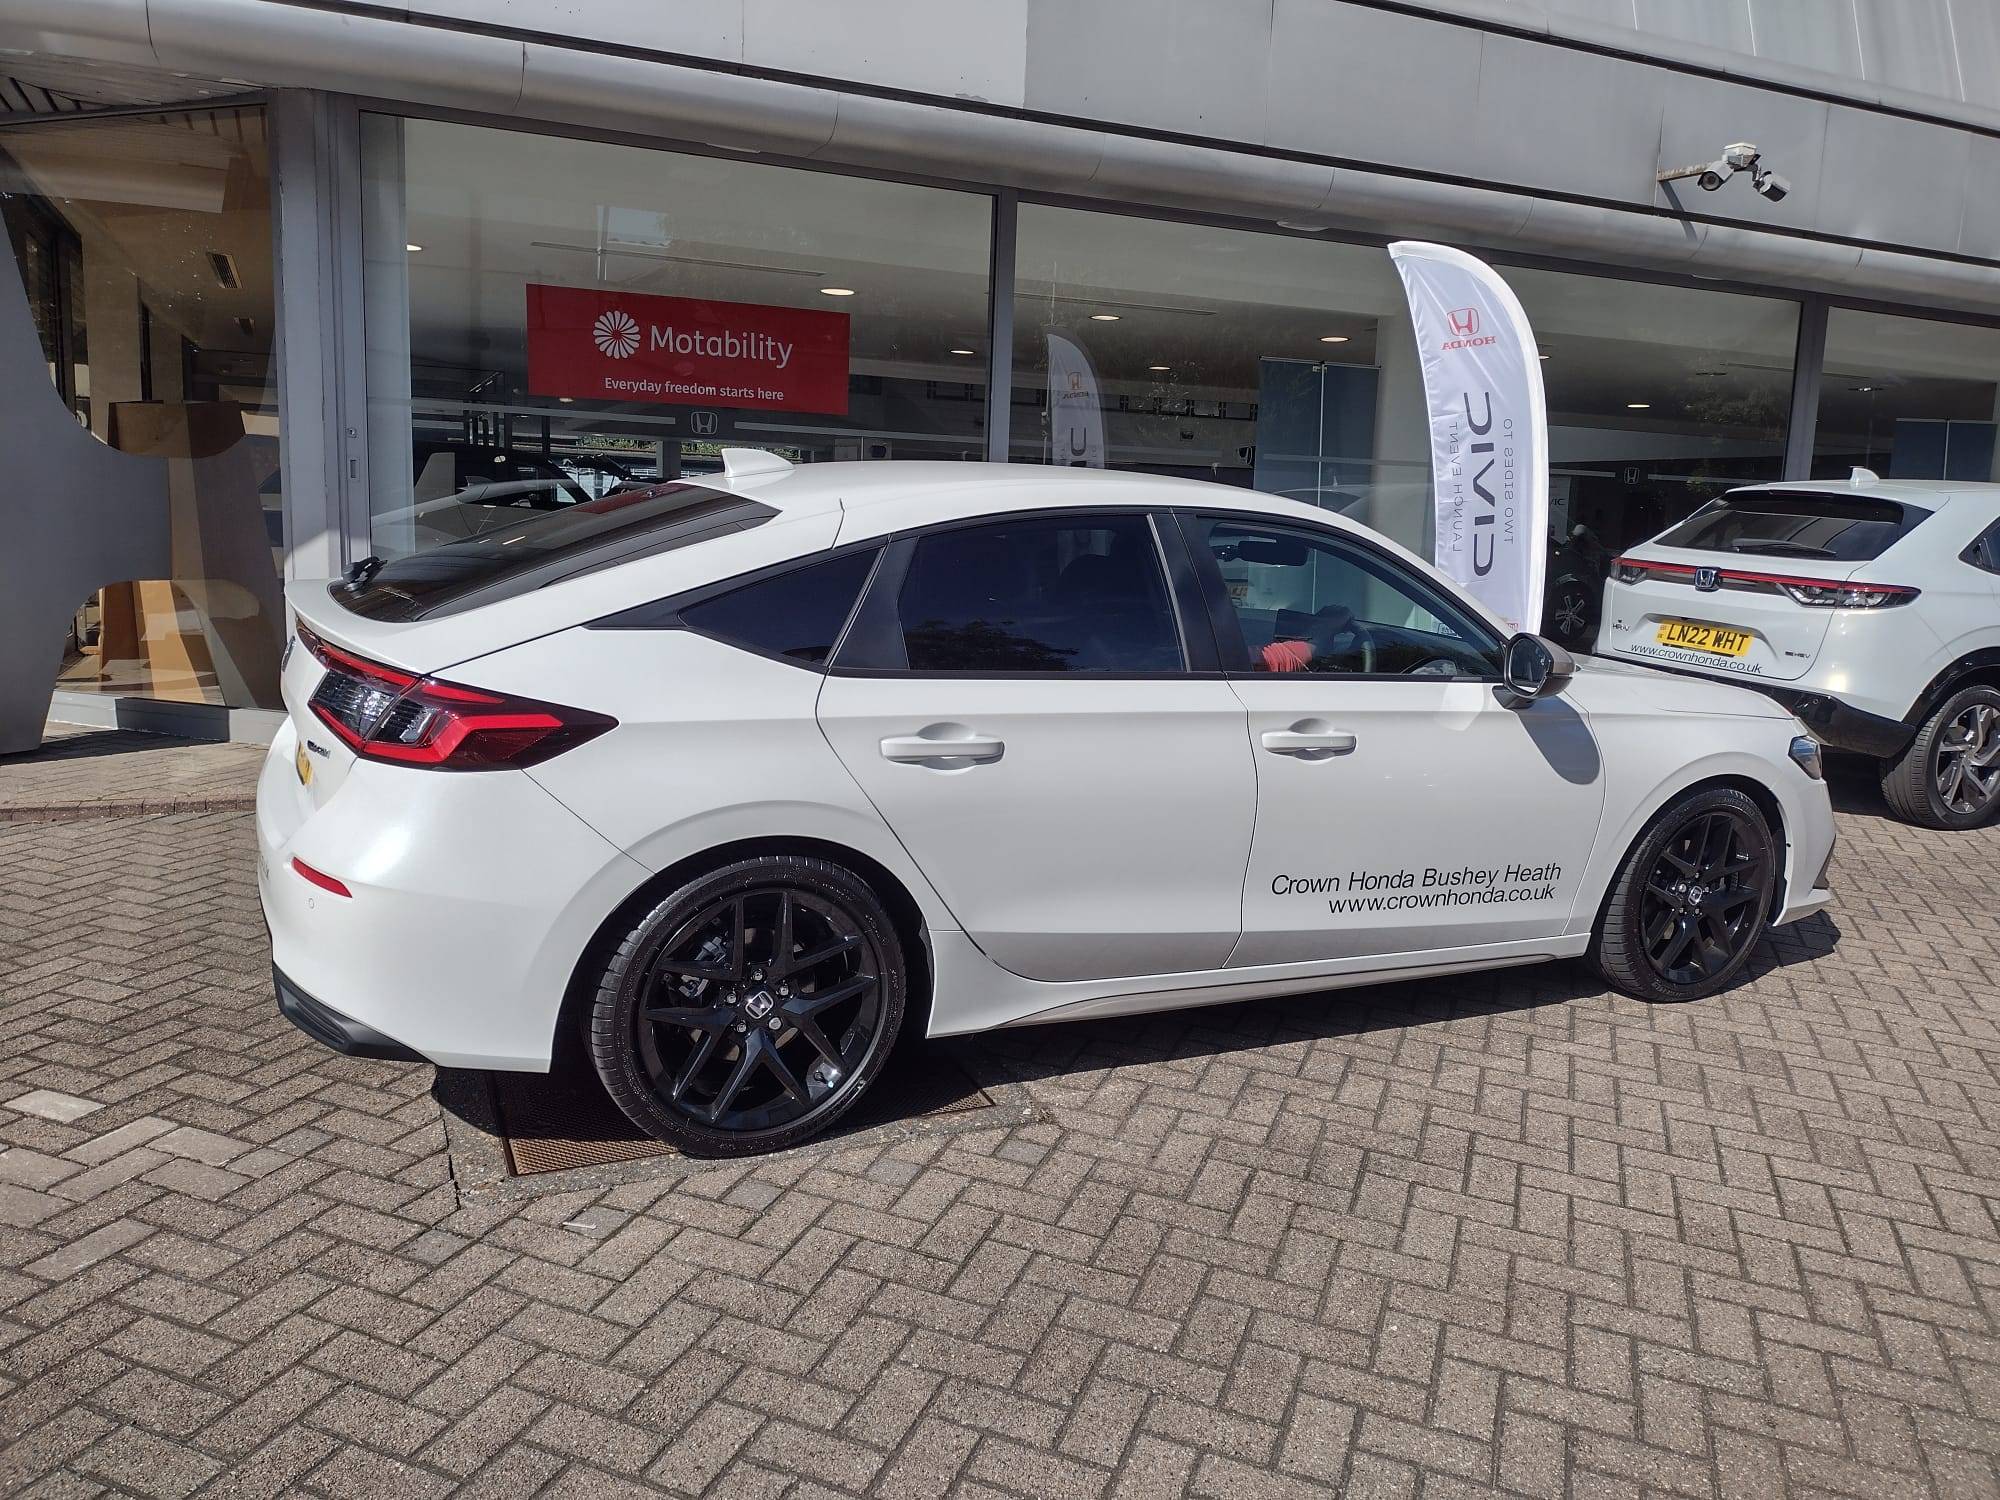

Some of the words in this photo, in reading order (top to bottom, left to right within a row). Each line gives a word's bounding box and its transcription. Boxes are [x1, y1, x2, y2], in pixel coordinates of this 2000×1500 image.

[650, 325, 793, 369] Motability
[604, 377, 662, 394] Everyday
[665, 380, 717, 395] freedom
[719, 385, 755, 399] starts
[757, 388, 784, 401] here
[1666, 623, 1709, 647] LN22
[1711, 629, 1749, 652] WHT
[1630, 643, 1762, 674] www.crownhonda.co.uk
[1271, 874, 1340, 895] Crown
[1348, 870, 1415, 892] Honda
[1421, 866, 1499, 889] Bushey
[1504, 862, 1562, 883] Heath
[1328, 884, 1555, 913] www.crownhonda.co.uk
